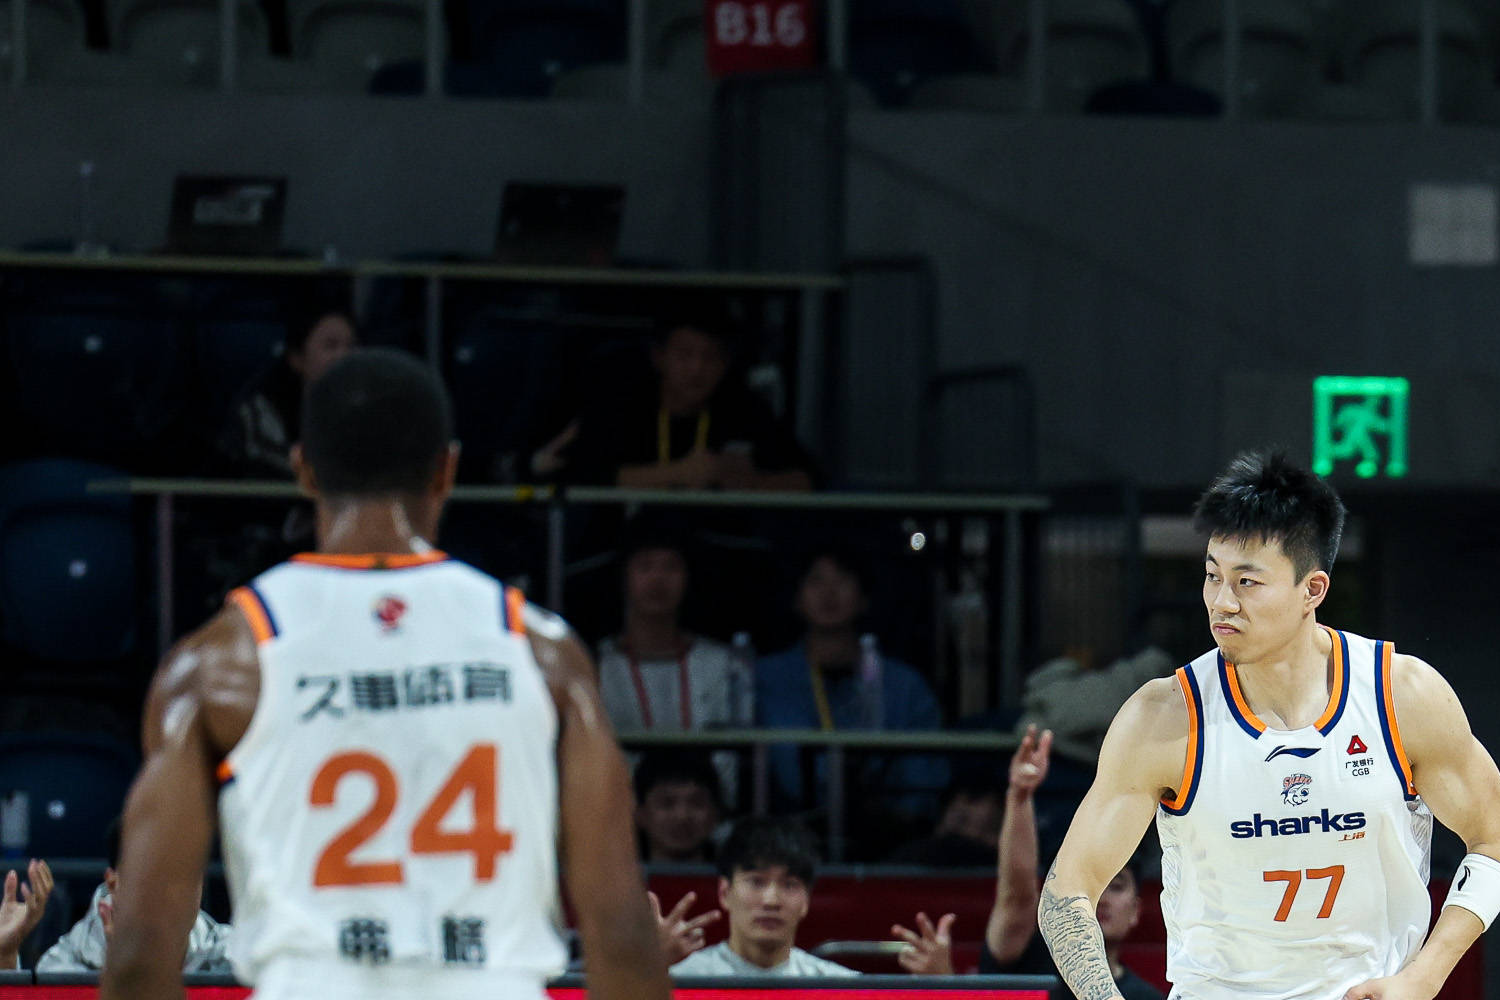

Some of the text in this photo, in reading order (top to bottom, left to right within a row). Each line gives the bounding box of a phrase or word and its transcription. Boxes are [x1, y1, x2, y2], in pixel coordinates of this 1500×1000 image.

[716, 1, 805, 47] B16
[1345, 757, 1374, 769] 广发银行
[1352, 767, 1370, 777] CGB
[309, 741, 515, 889] 24
[1230, 808, 1367, 839] sharks
[1263, 864, 1346, 923] 77
